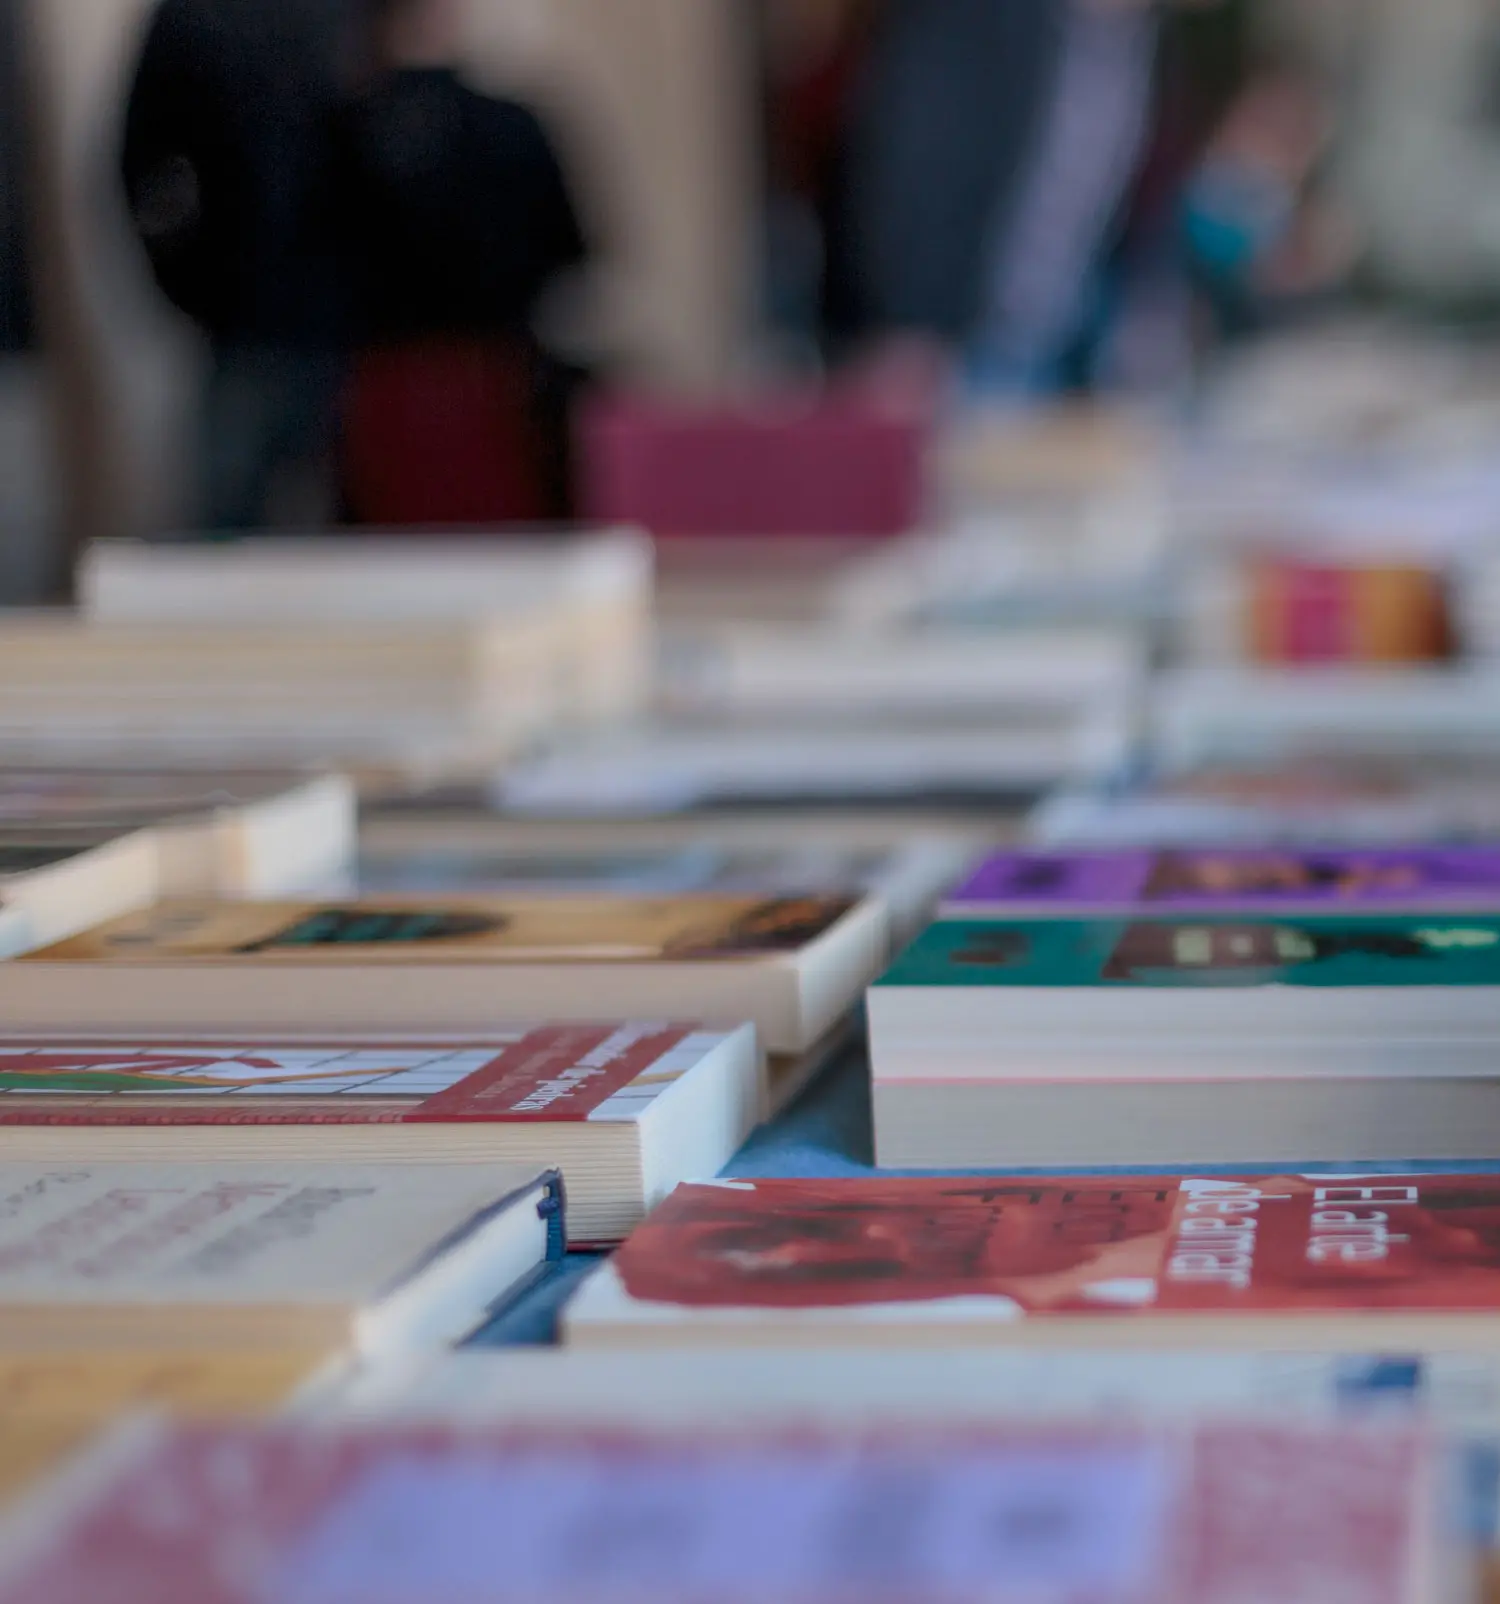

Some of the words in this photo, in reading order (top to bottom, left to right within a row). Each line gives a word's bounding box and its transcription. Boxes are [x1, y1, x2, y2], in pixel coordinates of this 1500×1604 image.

[1183, 1188, 1293, 1214] de
[1312, 1186, 1419, 1209] El
[1166, 1215, 1258, 1288] amar
[1305, 1209, 1411, 1263] arte
